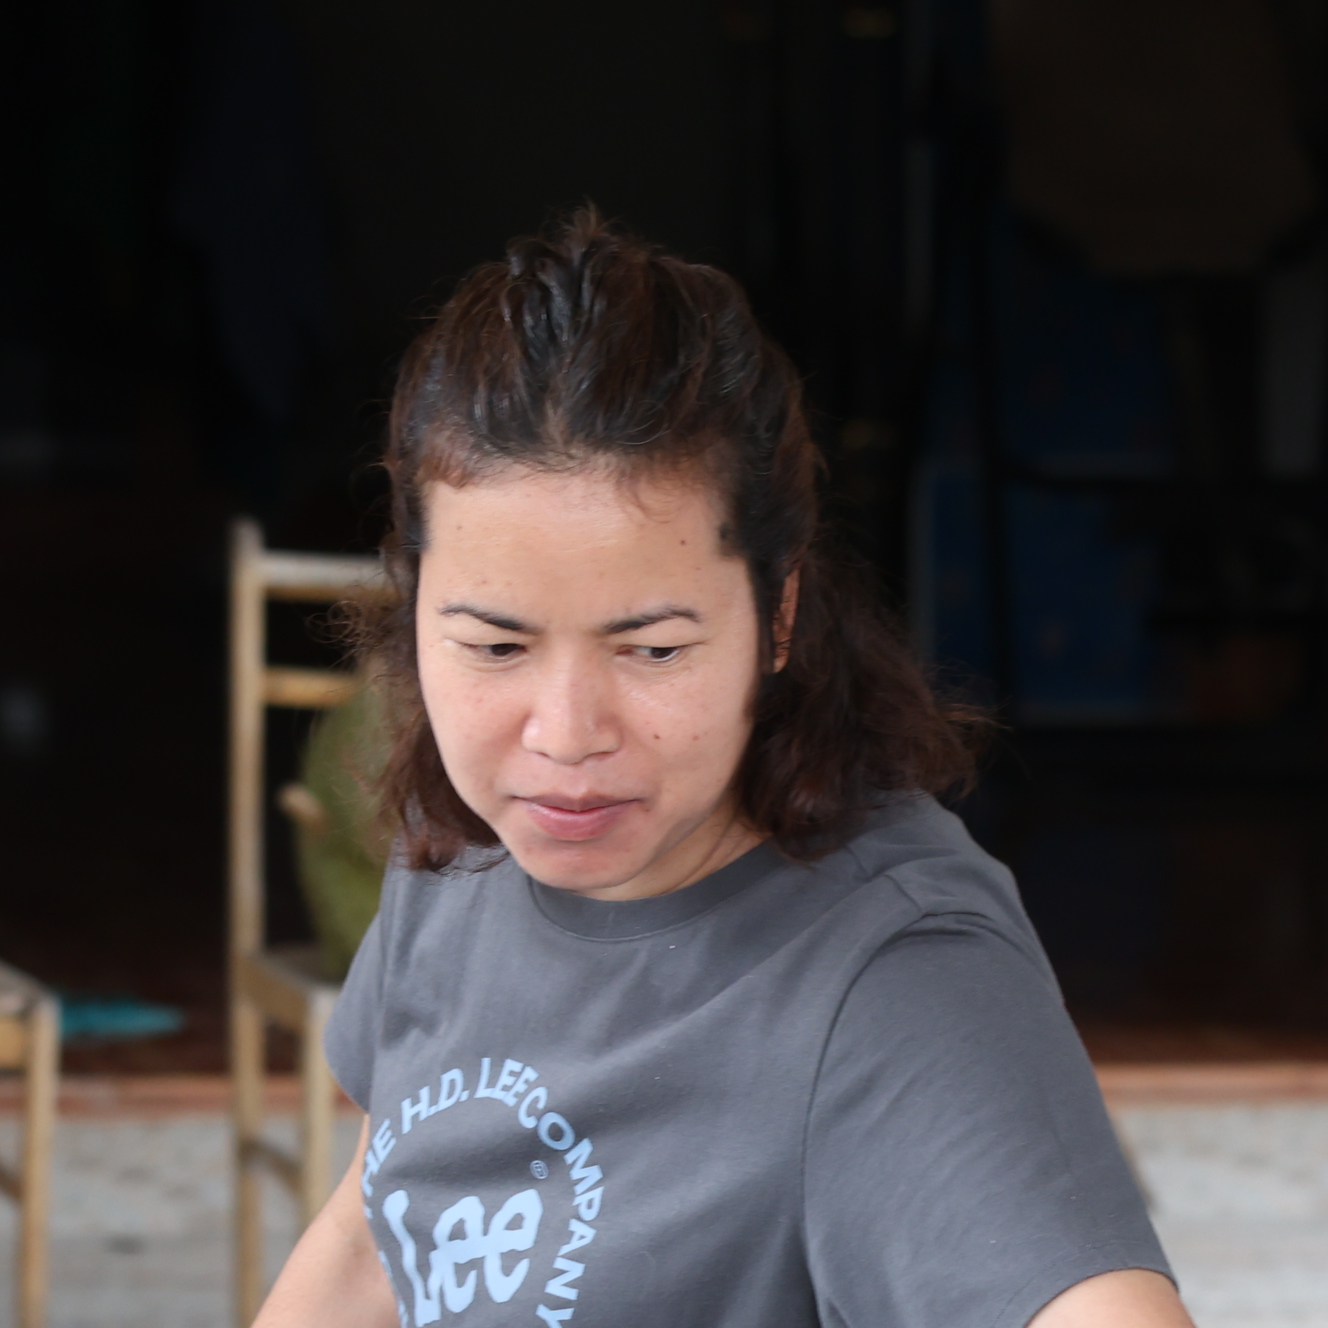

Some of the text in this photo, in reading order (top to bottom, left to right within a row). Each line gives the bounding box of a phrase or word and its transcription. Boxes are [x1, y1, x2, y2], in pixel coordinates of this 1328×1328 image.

[361, 1118, 397, 1220] HE
[401, 1068, 470, 1134] H.D.
[474, 1057, 539, 1107] LEE
[382, 1189, 544, 1328] Lee
